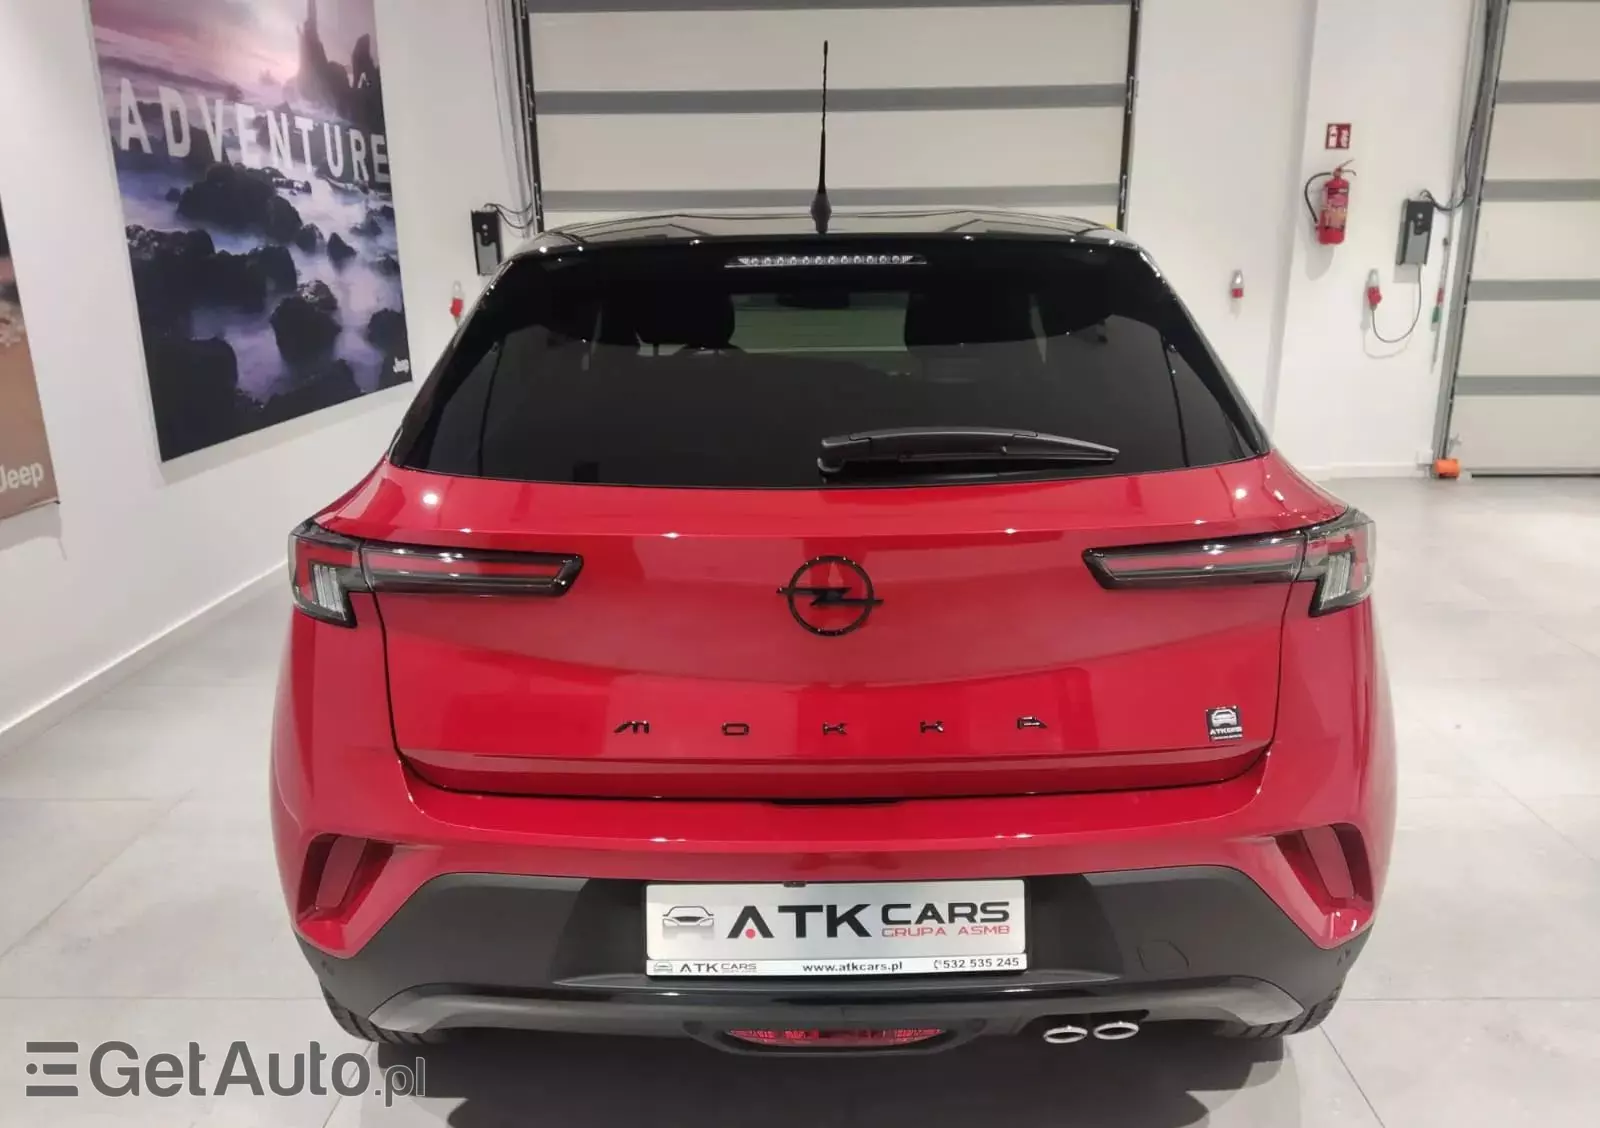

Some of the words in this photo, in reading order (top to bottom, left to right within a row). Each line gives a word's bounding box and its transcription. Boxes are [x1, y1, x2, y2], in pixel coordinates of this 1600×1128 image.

[119, 77, 391, 184] ADVENTURE
[727, 904, 872, 938] ATK
[881, 902, 1010, 925] CARS
[881, 927, 947, 937] GRUPA
[958, 925, 1010, 936] ASMB
[680, 963, 719, 973] ATK
[802, 961, 902, 972] www.atkcars.pl
[943, 959, 965, 969] 532
[970, 959, 992, 968] 535
[997, 957, 1019, 967] 245
